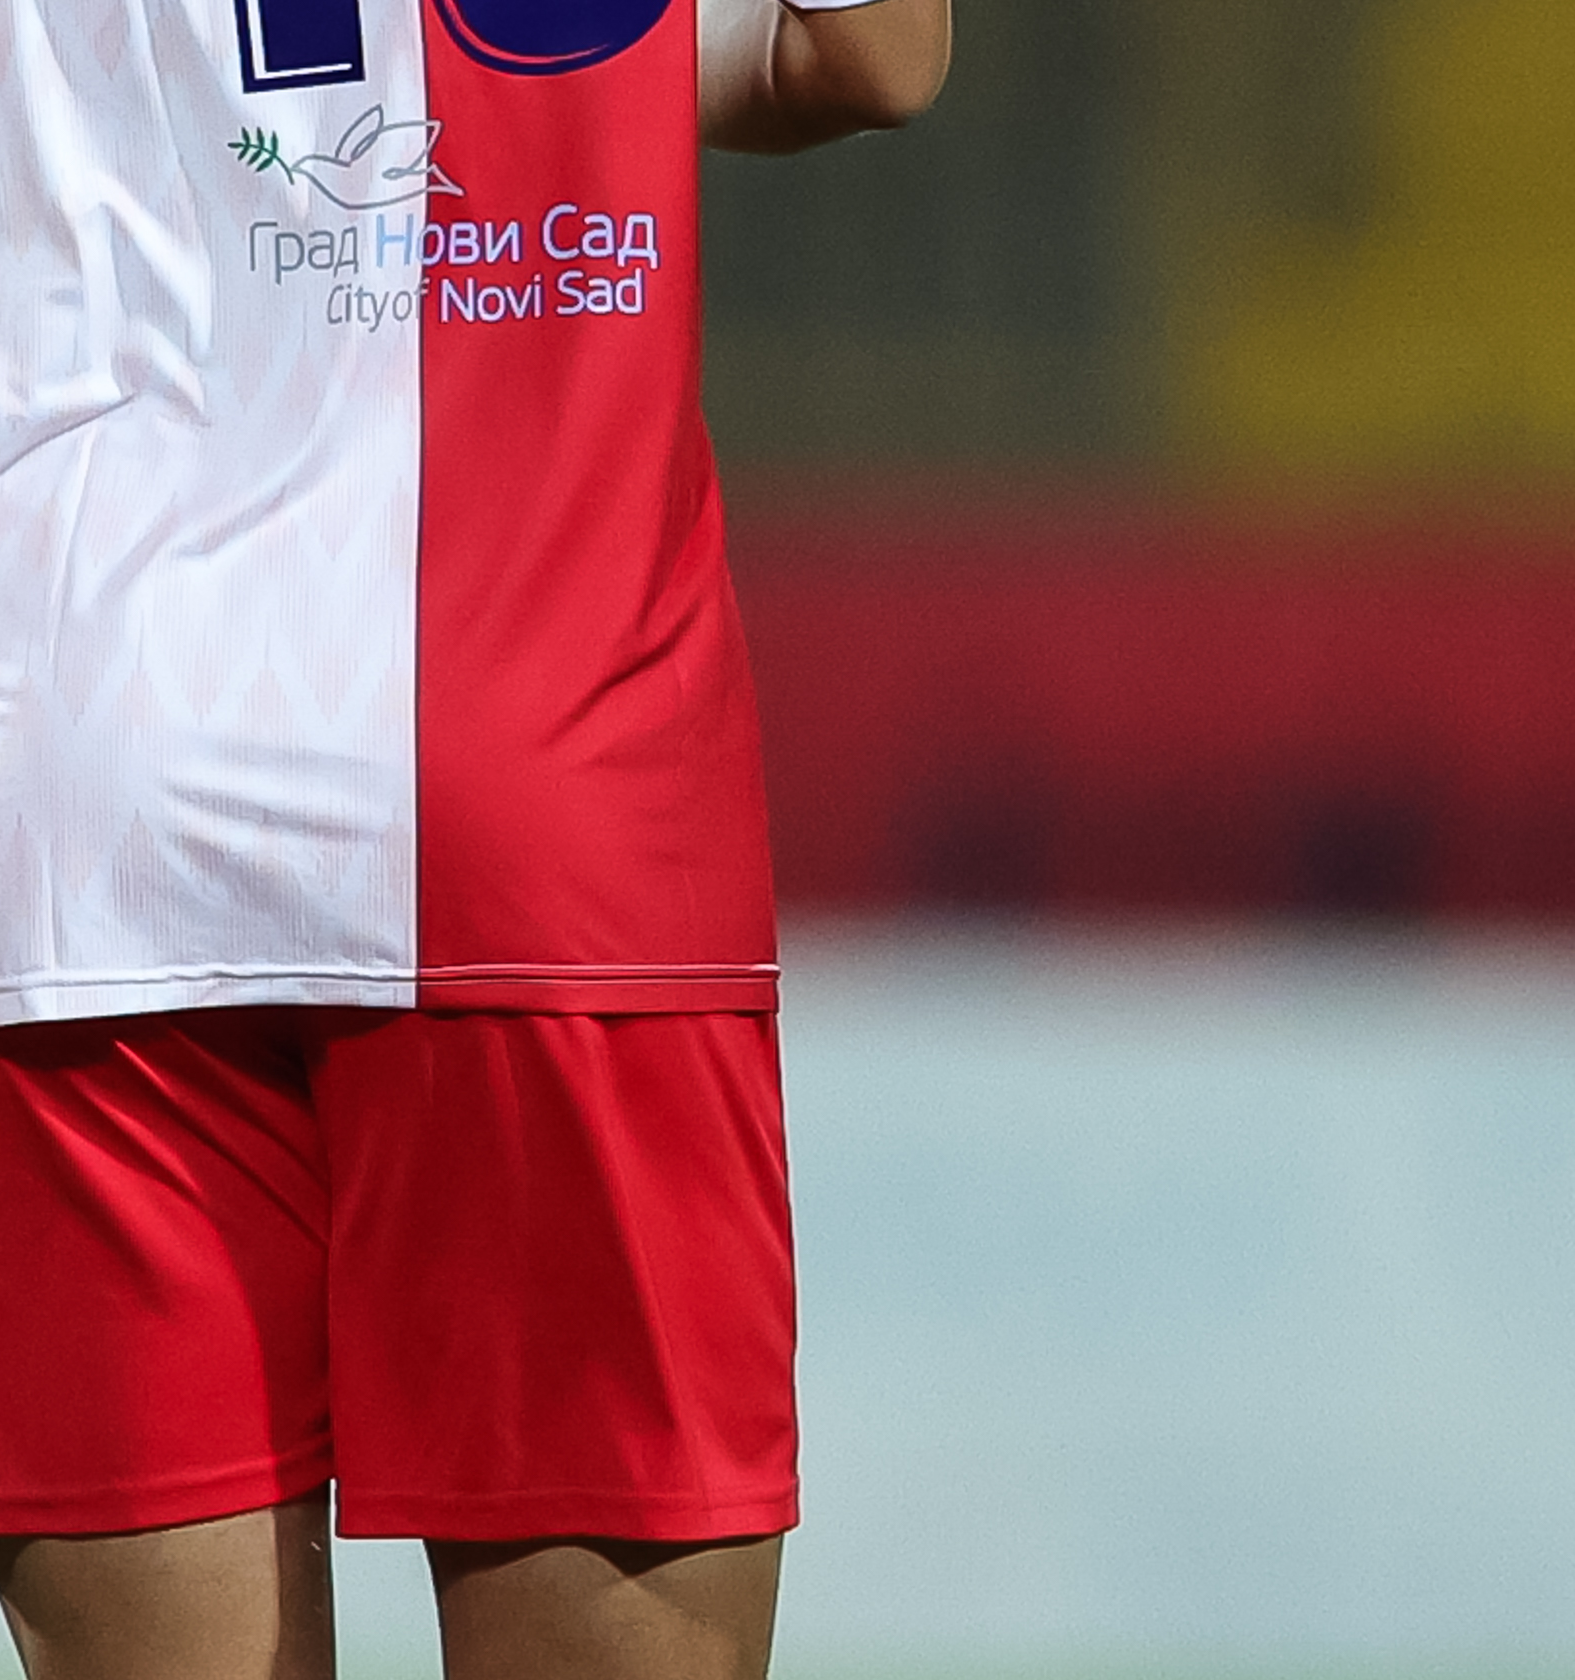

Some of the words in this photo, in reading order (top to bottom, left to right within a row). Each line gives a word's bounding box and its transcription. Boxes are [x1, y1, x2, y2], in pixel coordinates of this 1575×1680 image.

[249, 221, 360, 285] Град
[376, 213, 522, 268] Нови
[542, 204, 659, 270] Сад
[439, 273, 543, 324] Novi
[555, 267, 644, 316] Sad
